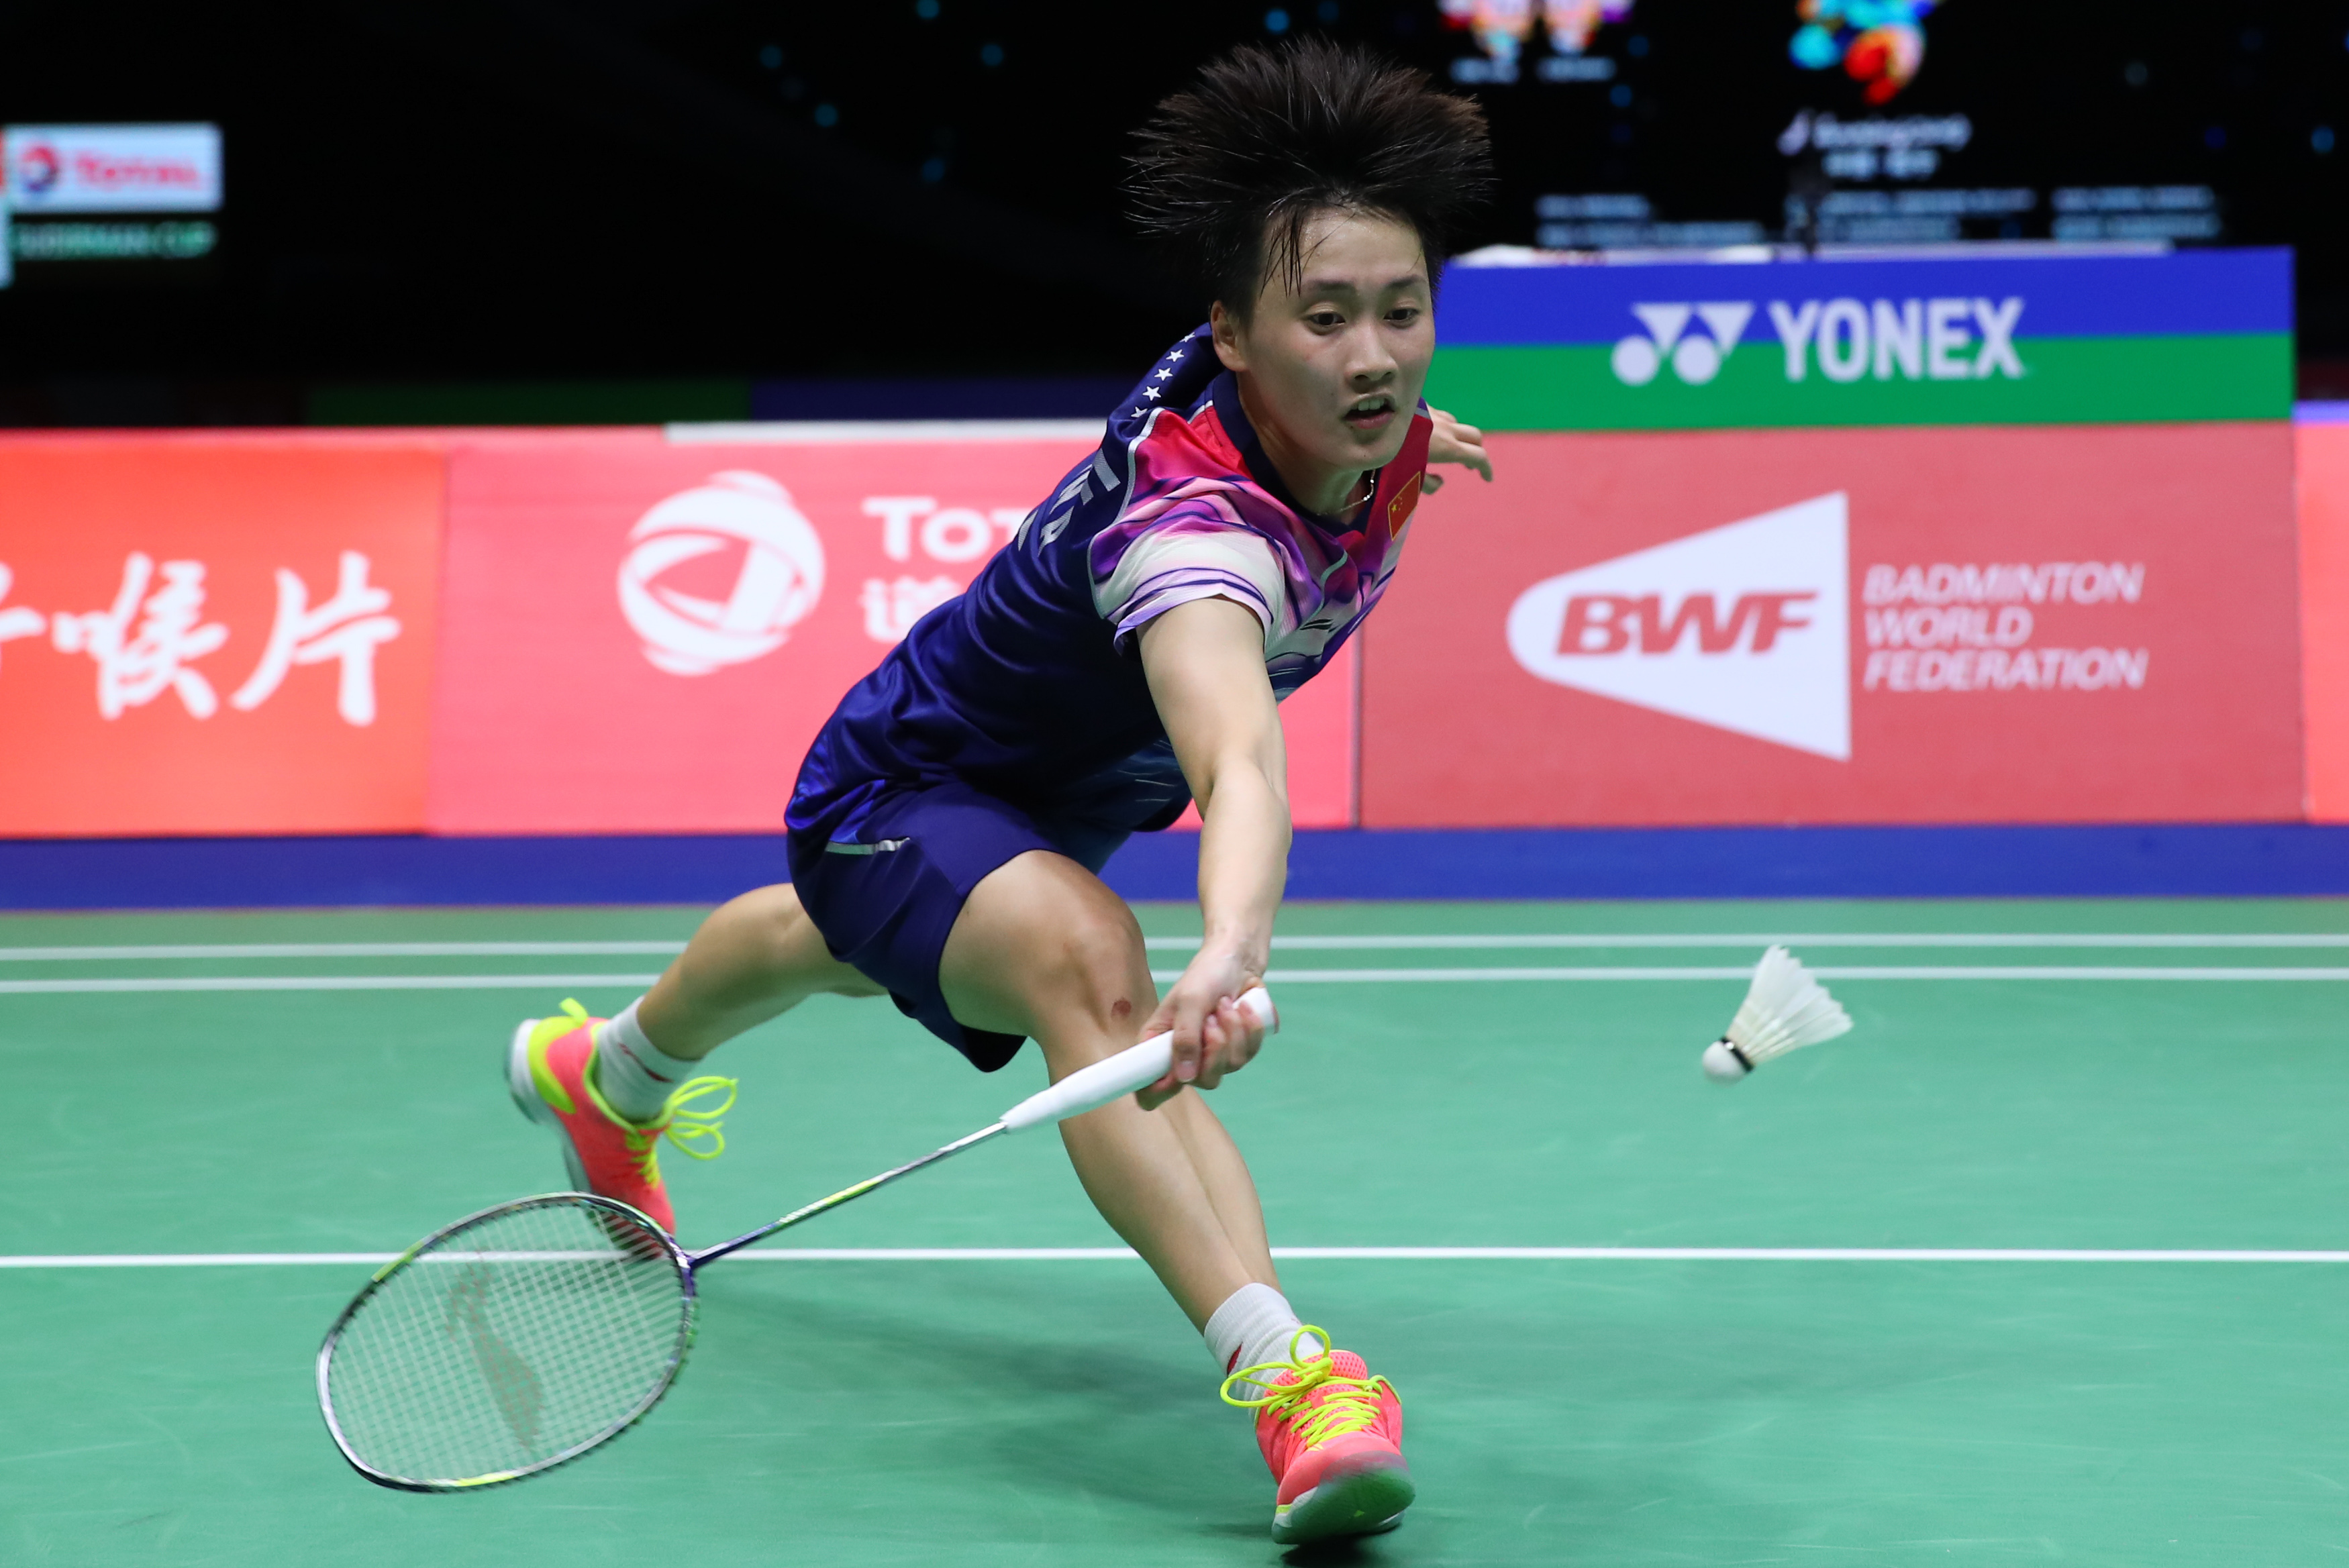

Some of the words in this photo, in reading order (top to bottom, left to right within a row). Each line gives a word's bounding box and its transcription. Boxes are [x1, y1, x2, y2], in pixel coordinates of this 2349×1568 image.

[1768, 297, 2025, 382] YONEX
[1864, 562, 2145, 603] BADMINTON
[1555, 592, 1819, 655] BWF
[1864, 605, 2034, 647] WORLD
[1864, 647, 2148, 691] FEDERATION
